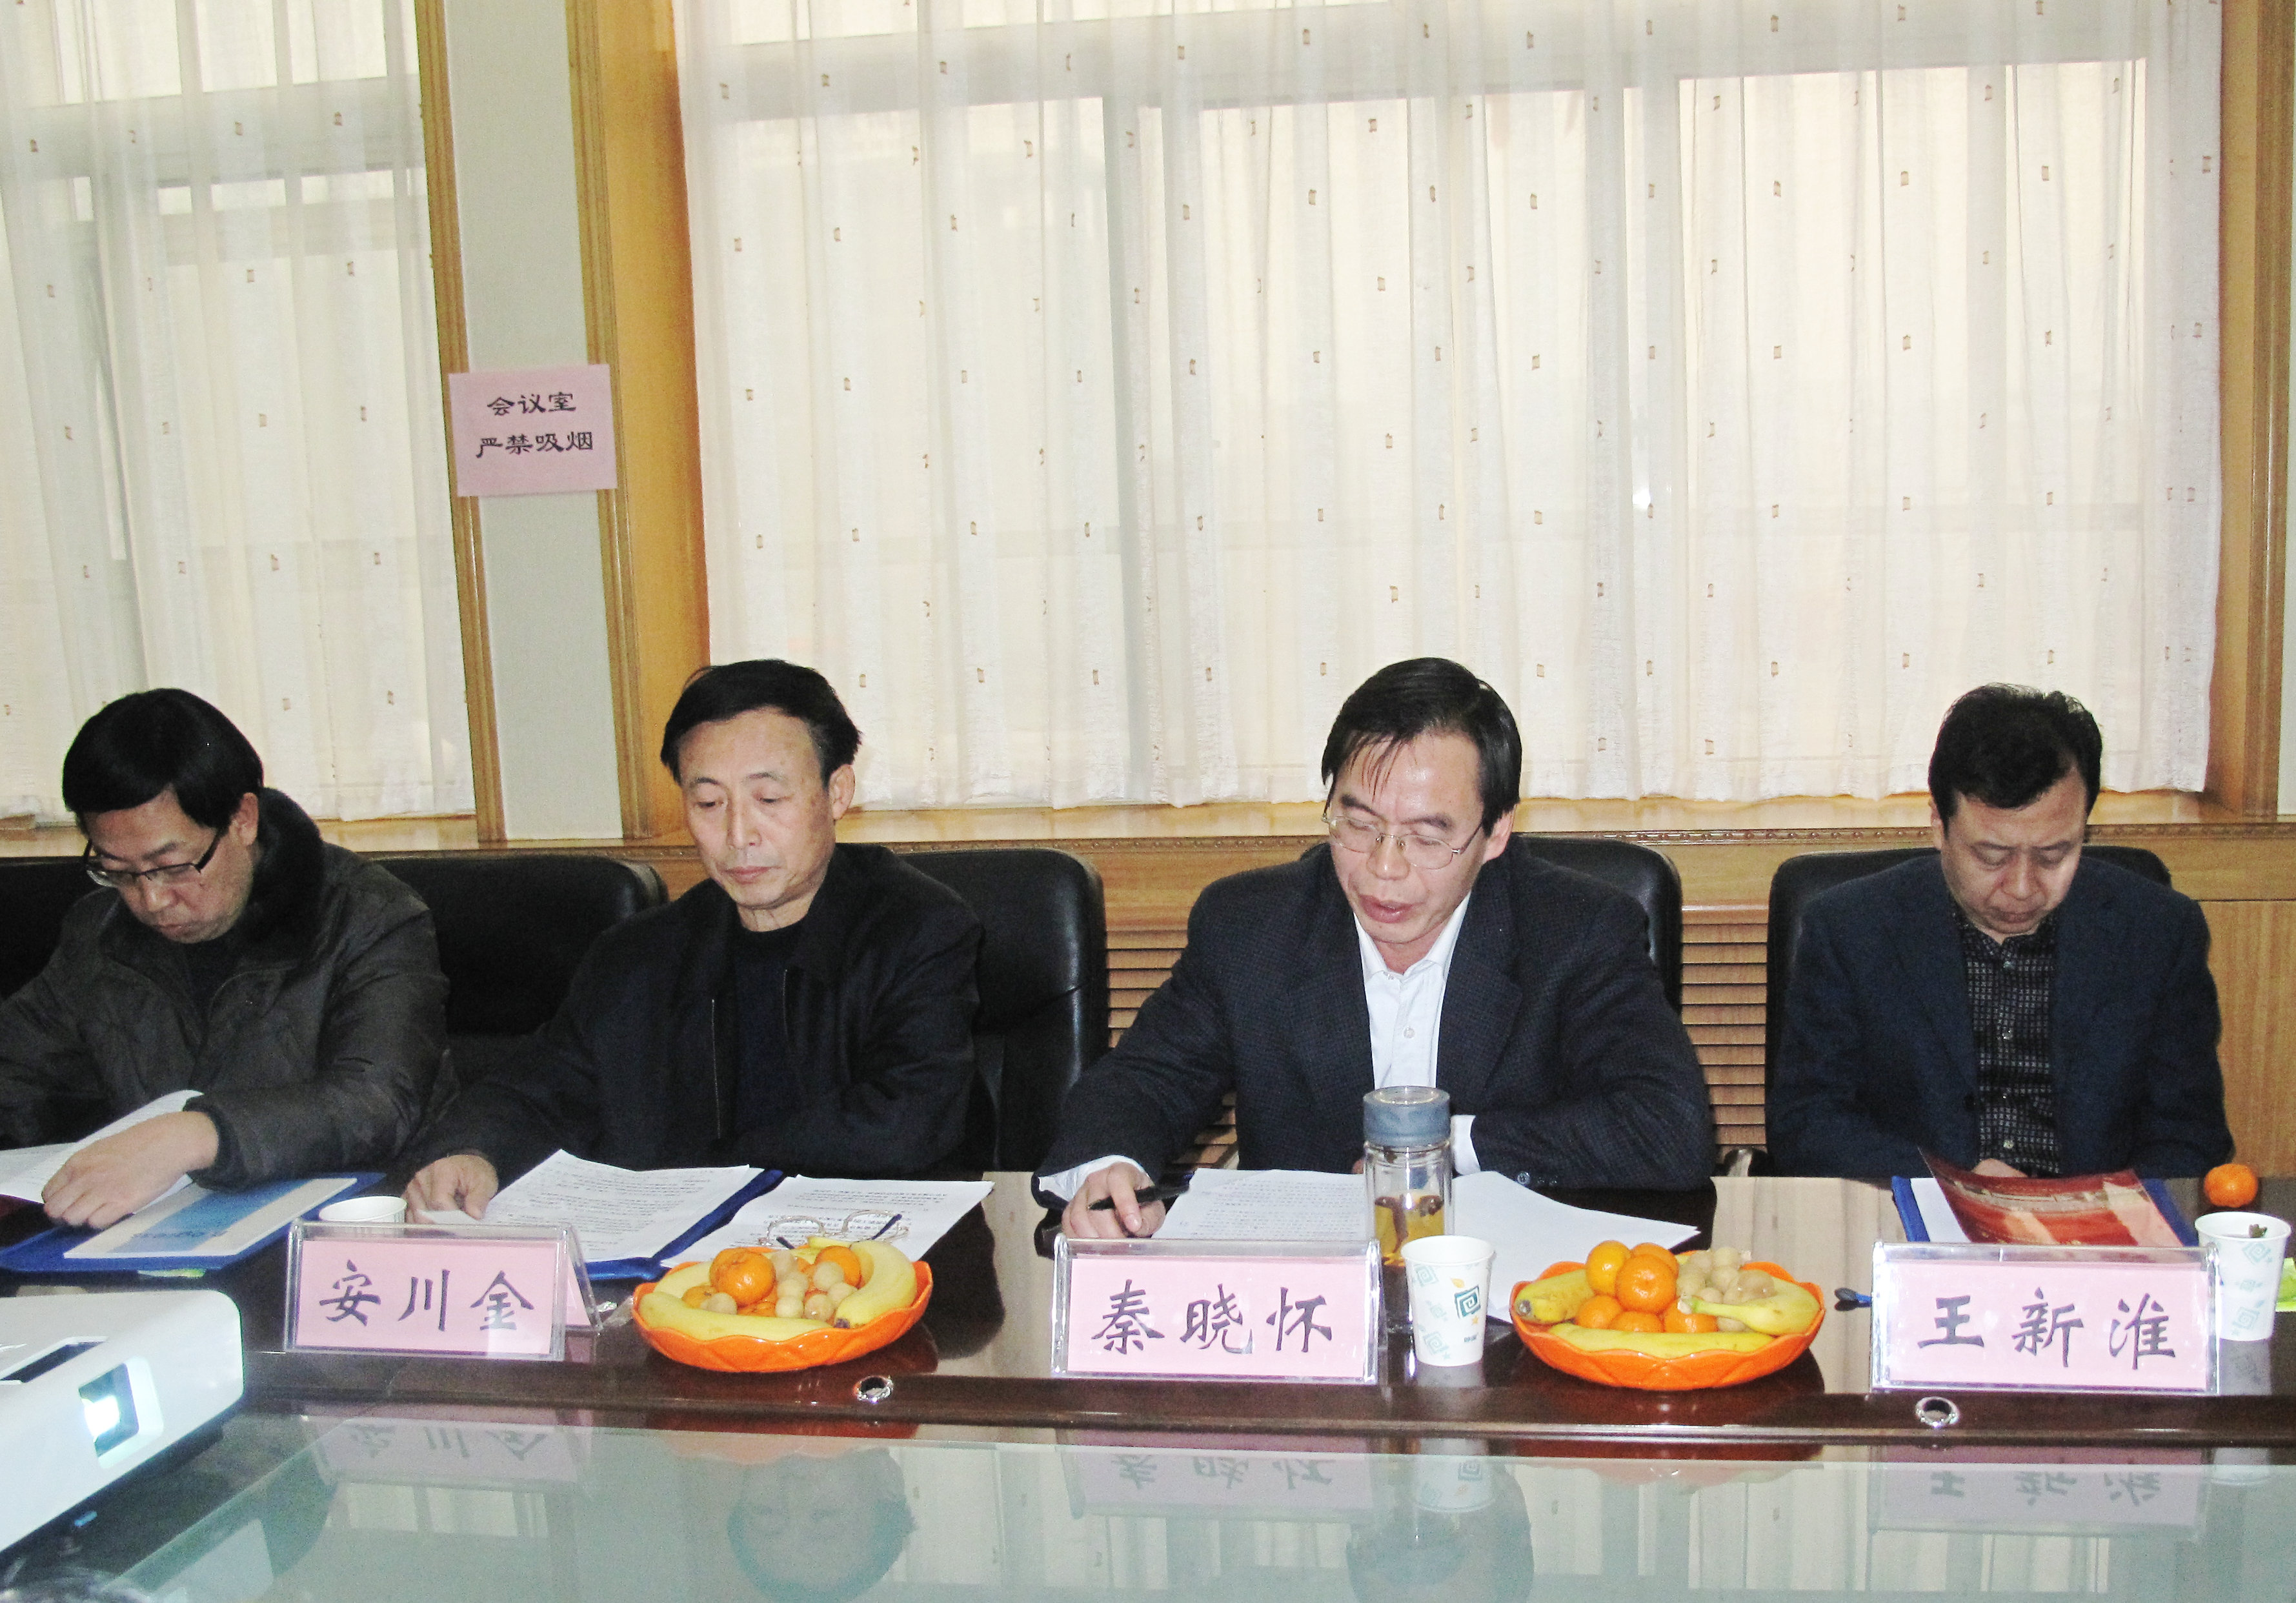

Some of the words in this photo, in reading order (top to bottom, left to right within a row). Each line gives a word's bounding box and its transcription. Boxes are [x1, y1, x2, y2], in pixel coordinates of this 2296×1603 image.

[487, 391, 576, 416] 会议室
[476, 431, 594, 459] 严禁吸烟
[319, 1259, 534, 1332] 安川金
[1091, 1278, 1333, 1355] 秦晓怀
[1917, 1287, 2176, 1370] 王新淮
